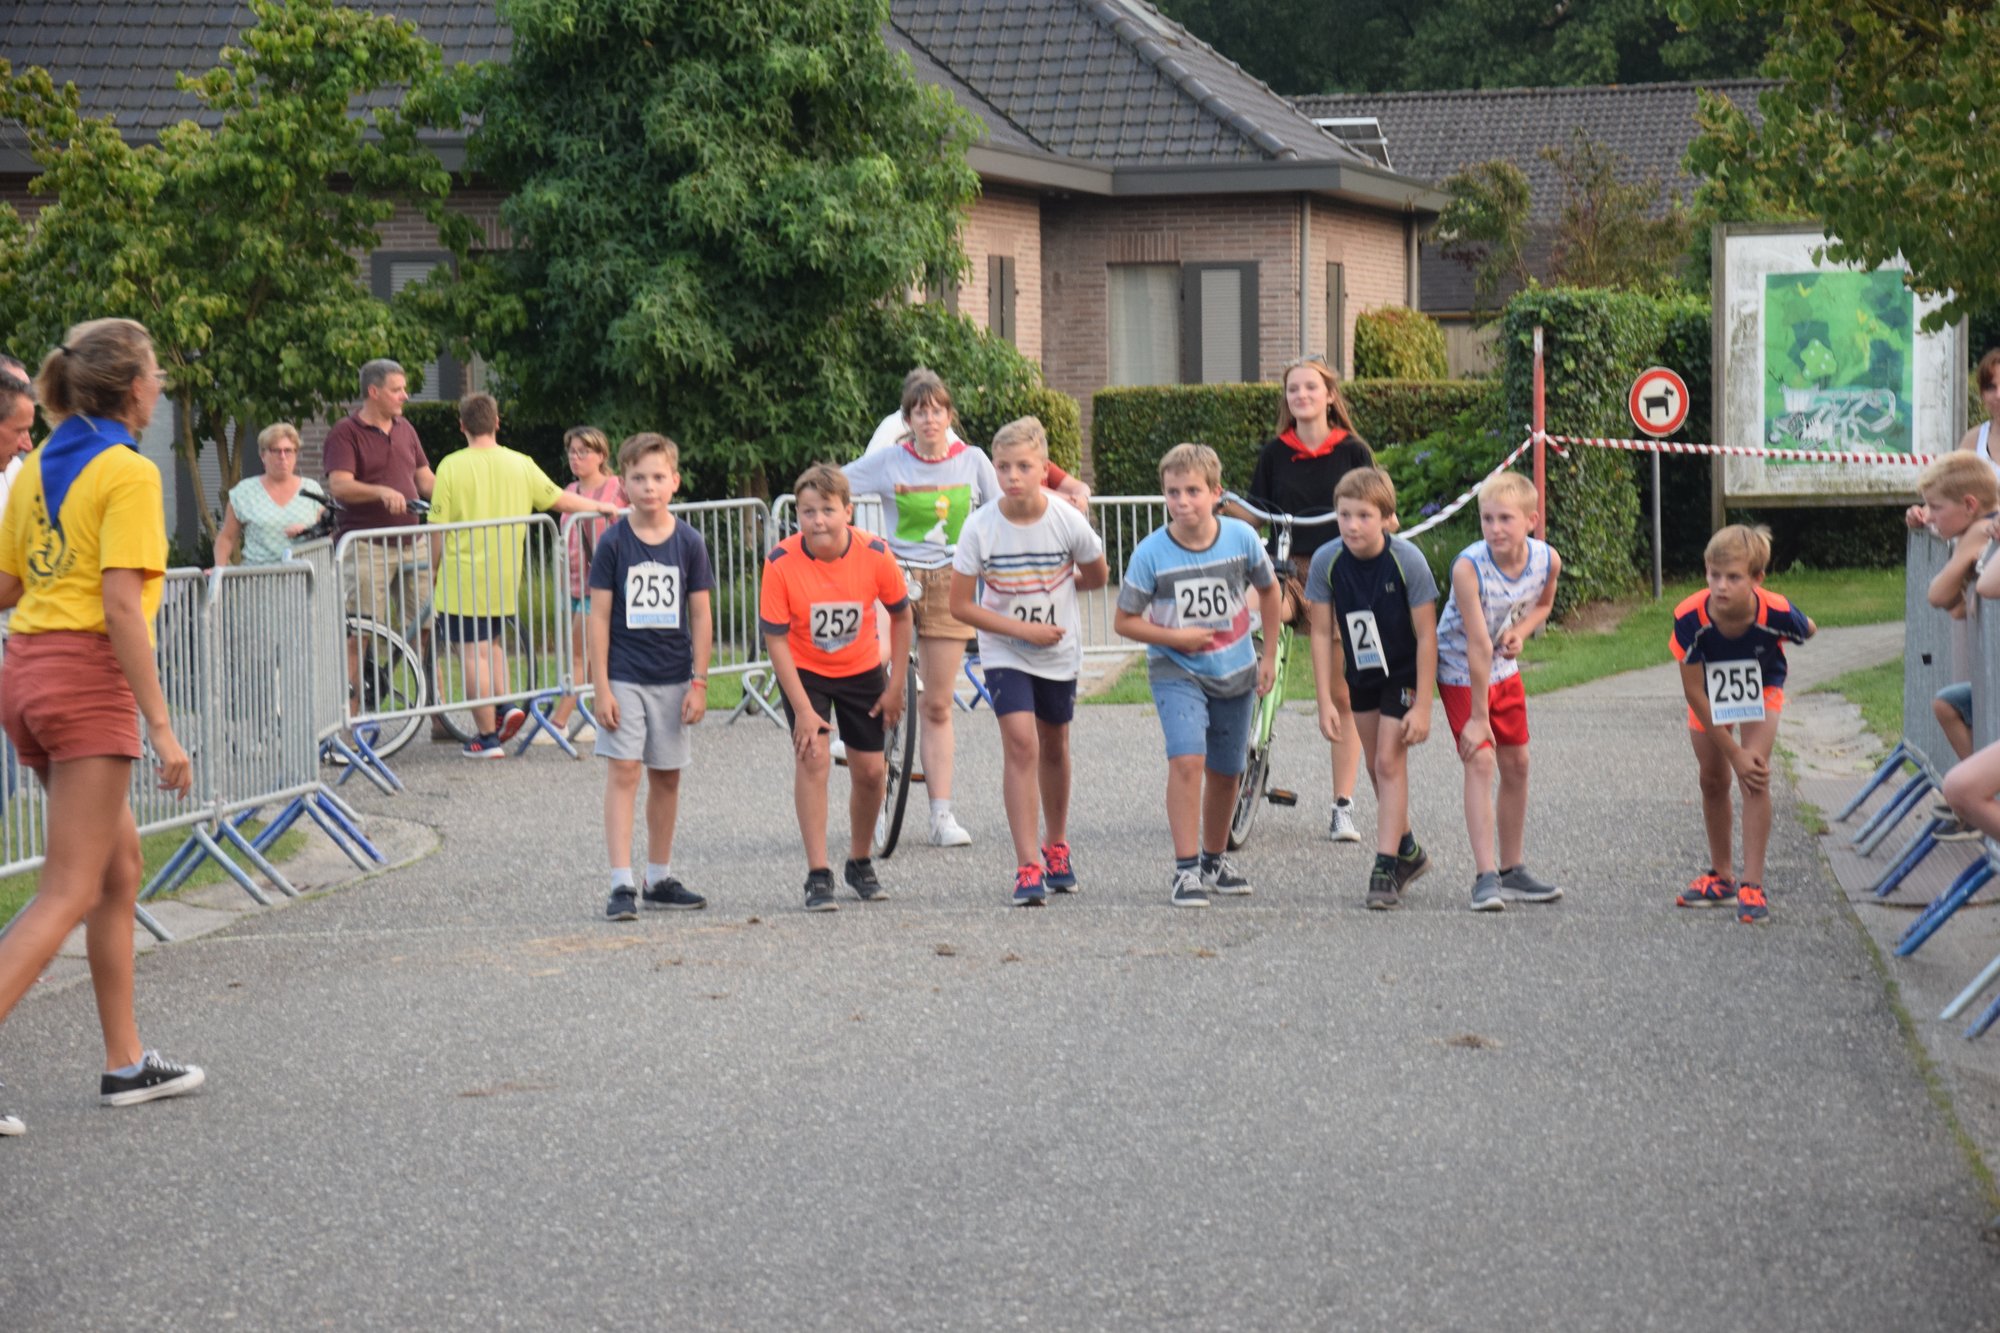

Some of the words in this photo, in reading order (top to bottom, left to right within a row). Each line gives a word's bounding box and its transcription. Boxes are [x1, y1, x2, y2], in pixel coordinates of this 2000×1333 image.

[631, 574, 675, 608] 253
[1180, 584, 1229, 619] 256
[814, 608, 859, 638] 252
[1712, 668, 1760, 703] 255
